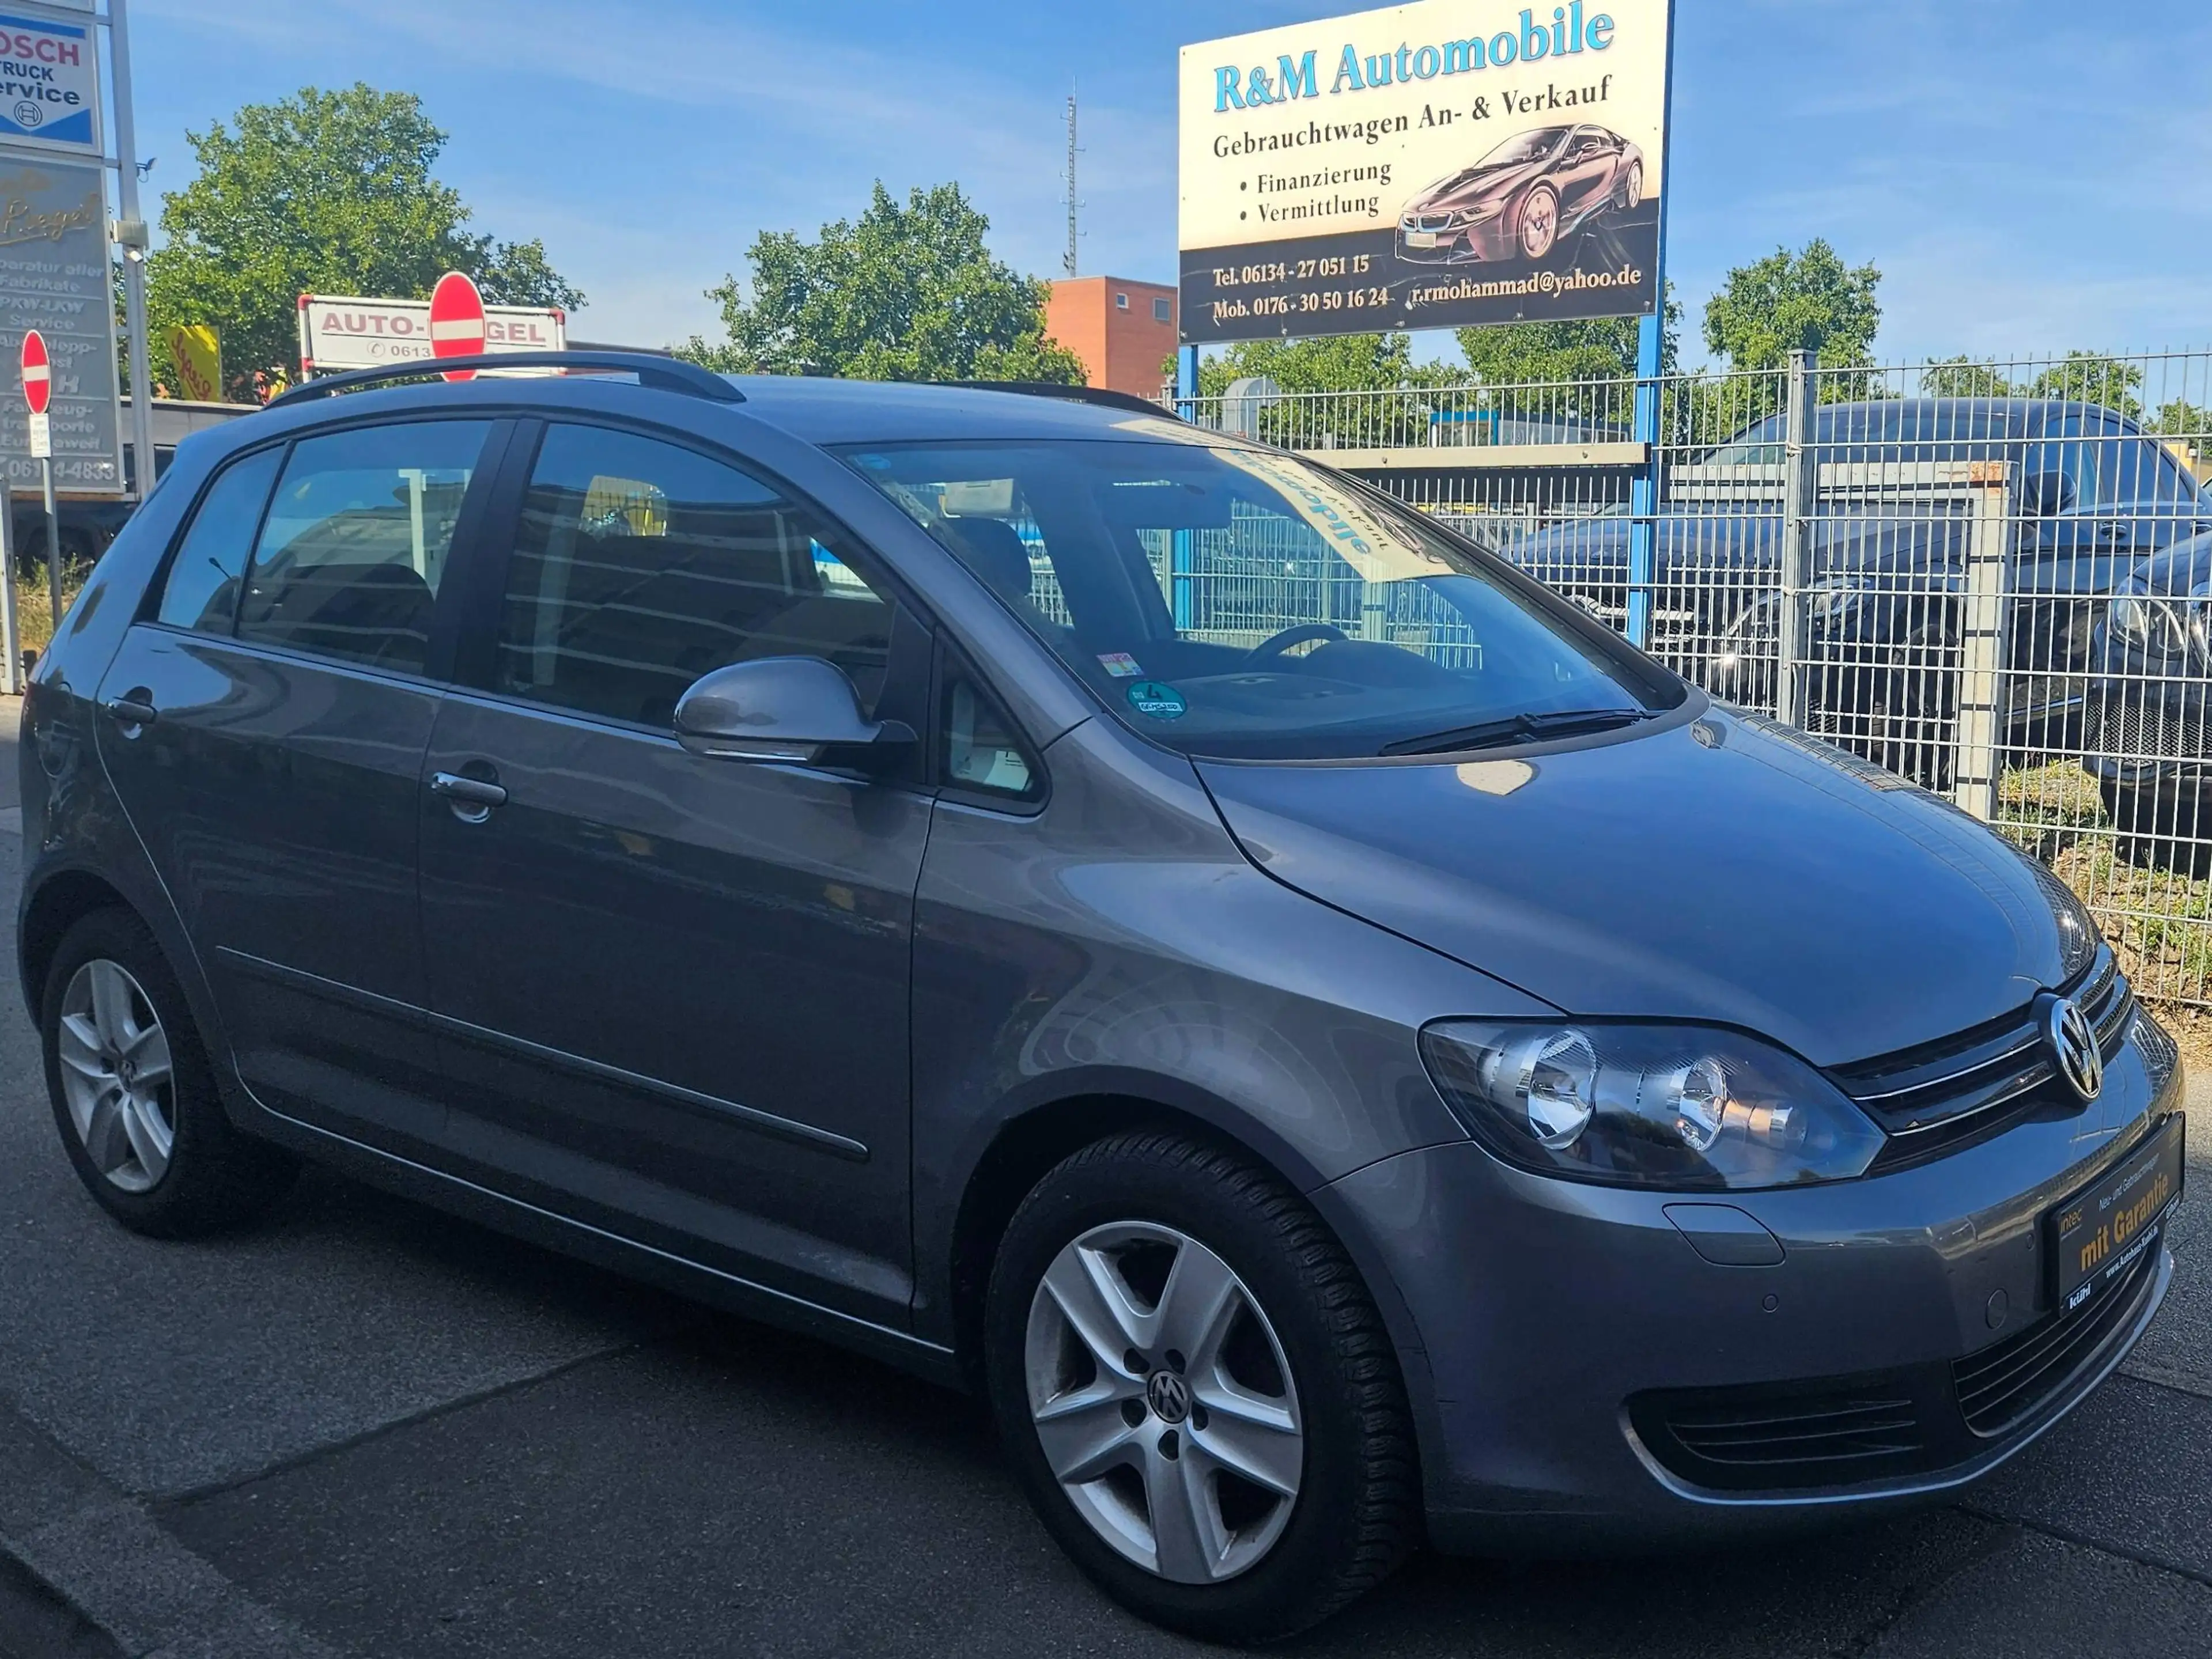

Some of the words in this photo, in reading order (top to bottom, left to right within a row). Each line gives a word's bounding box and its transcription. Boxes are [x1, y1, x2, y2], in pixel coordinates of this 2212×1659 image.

[1214, 50, 1319, 112] R&M
[1330, 0, 1614, 93] Automobile
[0, 60, 54, 82] RUCK
[0, 82, 80, 105] rvice
[1214, 115, 1408, 157] Gebrauchtwagen
[1420, 104, 1462, 128] An-
[1472, 96, 1491, 120] &
[1502, 74, 1612, 115] Verkauf
[1258, 164, 1391, 193] Finanzierung
[1258, 195, 1379, 222] Vermittlung
[65, 263, 104, 278] aller
[1213, 267, 1238, 286] Tel.
[1242, 263, 1285, 284] 06134
[1297, 260, 1316, 278] 27
[1319, 257, 1345, 276] 051
[1353, 255, 1369, 273] 15
[1213, 300, 1250, 318] Mob.
[1254, 296, 1287, 315] 0176
[1300, 293, 1319, 312] 30
[1323, 291, 1342, 309] 50
[1348, 289, 1364, 308] 16
[1368, 287, 1389, 306] 24
[9, 314, 75, 330] Service
[391, 345, 430, 358] 0613
[2081, 1225, 2109, 1272] mit
[2114, 1173, 2168, 1243] Garantie
